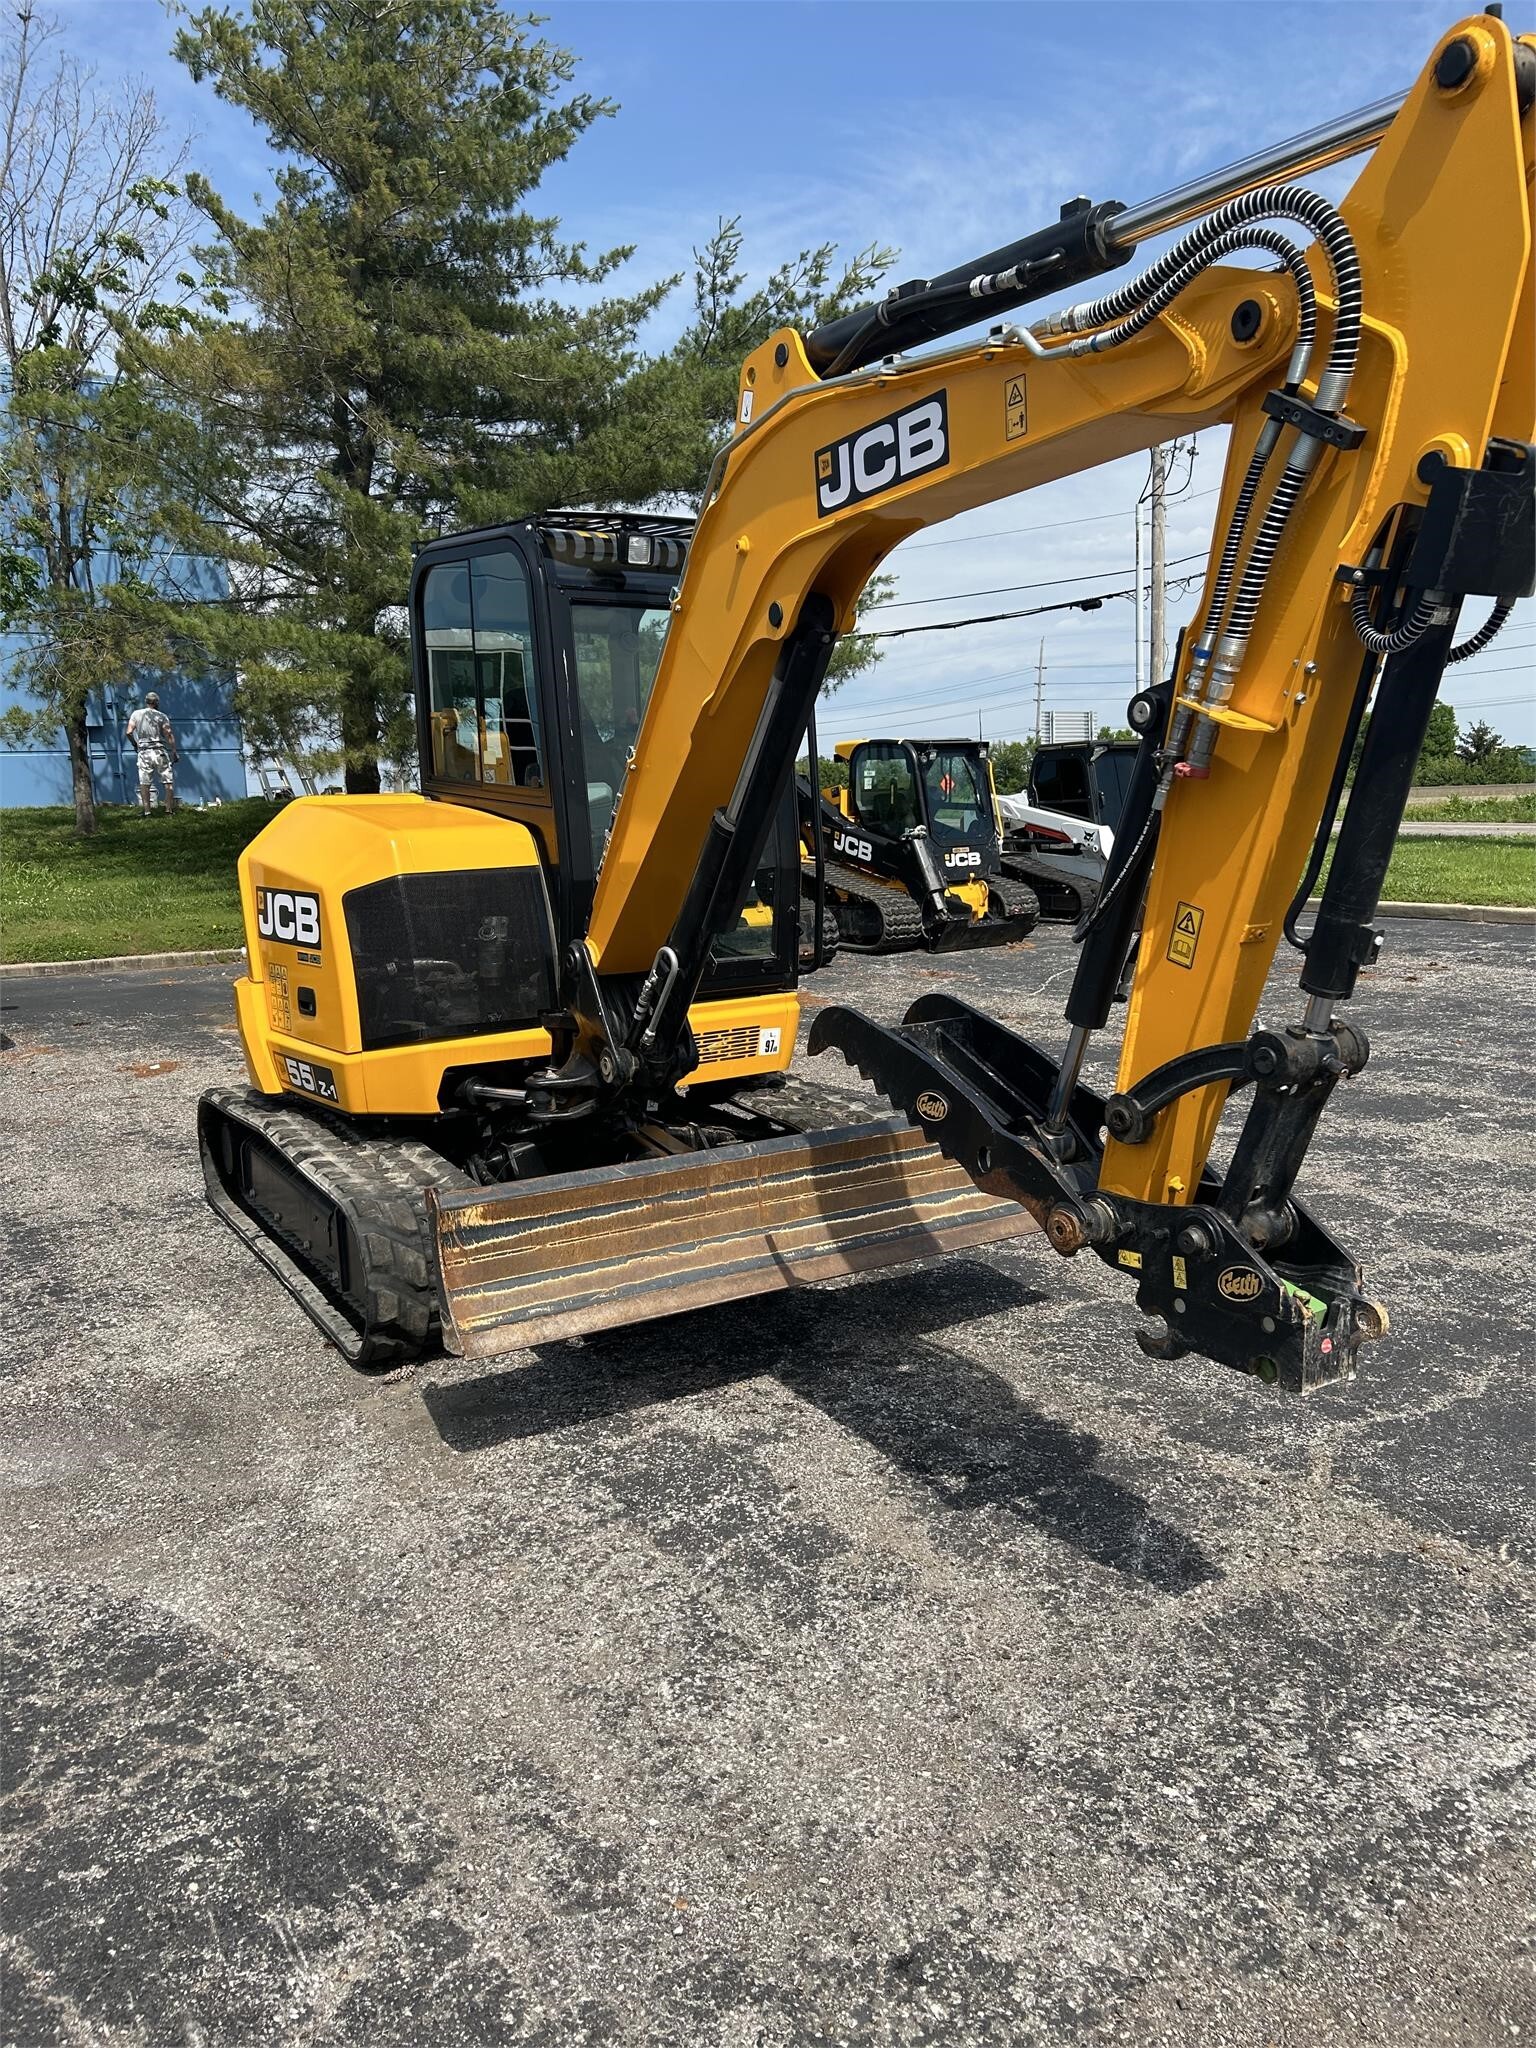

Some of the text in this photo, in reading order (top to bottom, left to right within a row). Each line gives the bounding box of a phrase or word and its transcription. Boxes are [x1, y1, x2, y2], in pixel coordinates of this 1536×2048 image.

[820, 401, 945, 508] JCB
[833, 833, 872, 861] JCB
[945, 852, 982, 867] JCB
[259, 892, 319, 944] JCB
[286, 1058, 315, 1091] 55
[1221, 1271, 1259, 1295] Geith
